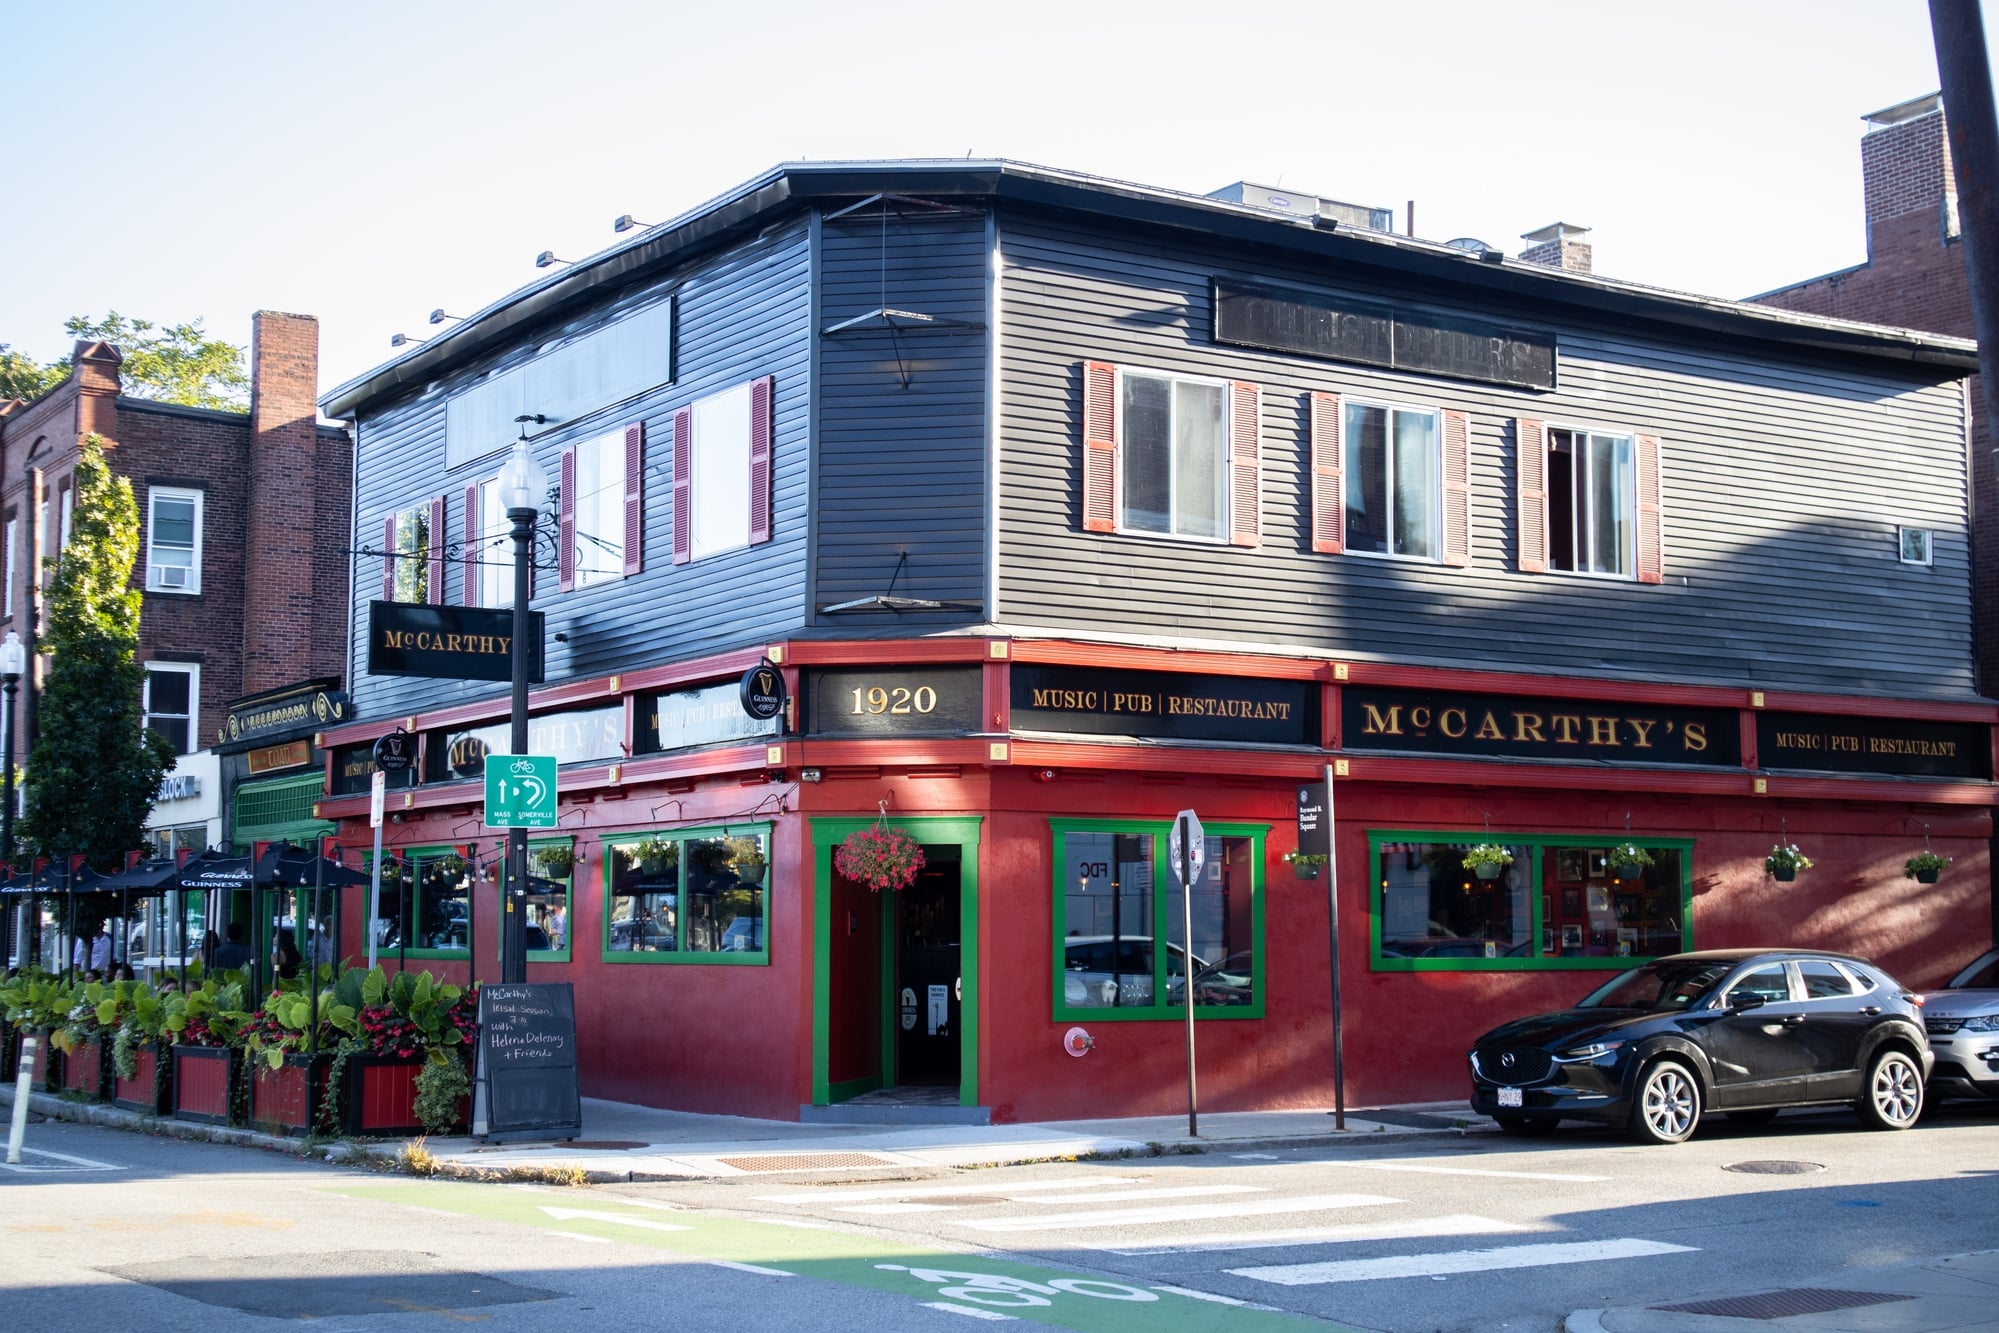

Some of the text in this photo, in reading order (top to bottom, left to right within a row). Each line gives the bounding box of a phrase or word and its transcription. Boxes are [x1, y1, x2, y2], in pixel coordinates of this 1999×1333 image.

[384, 630, 512, 655] McCARTHY
[753, 694, 778, 703] GUINNESS
[850, 685, 938, 716] 1920
[1032, 688, 1292, 721] MUSIC PUB RESTAURANT
[651, 711, 680, 730] MUSIC
[686, 706, 705, 724] PUB
[1360, 702, 1708, 752] McCARTHY'S
[451, 716, 617, 767] McCATHY'S
[1776, 731, 1957, 758] MUSIC PUB RESTAURANT
[382, 754, 408, 763] GUINNESS
[344, 762, 364, 777] MUSIC
[517, 811, 553, 819] SOMERVILLE
[1299, 822, 1317, 832] Square
[180, 879, 243, 888] GUINNESS
[487, 988, 531, 1000] McCarthy's
[491, 1033, 525, 1048] Helena
[514, 1048, 553, 1059] Friends
